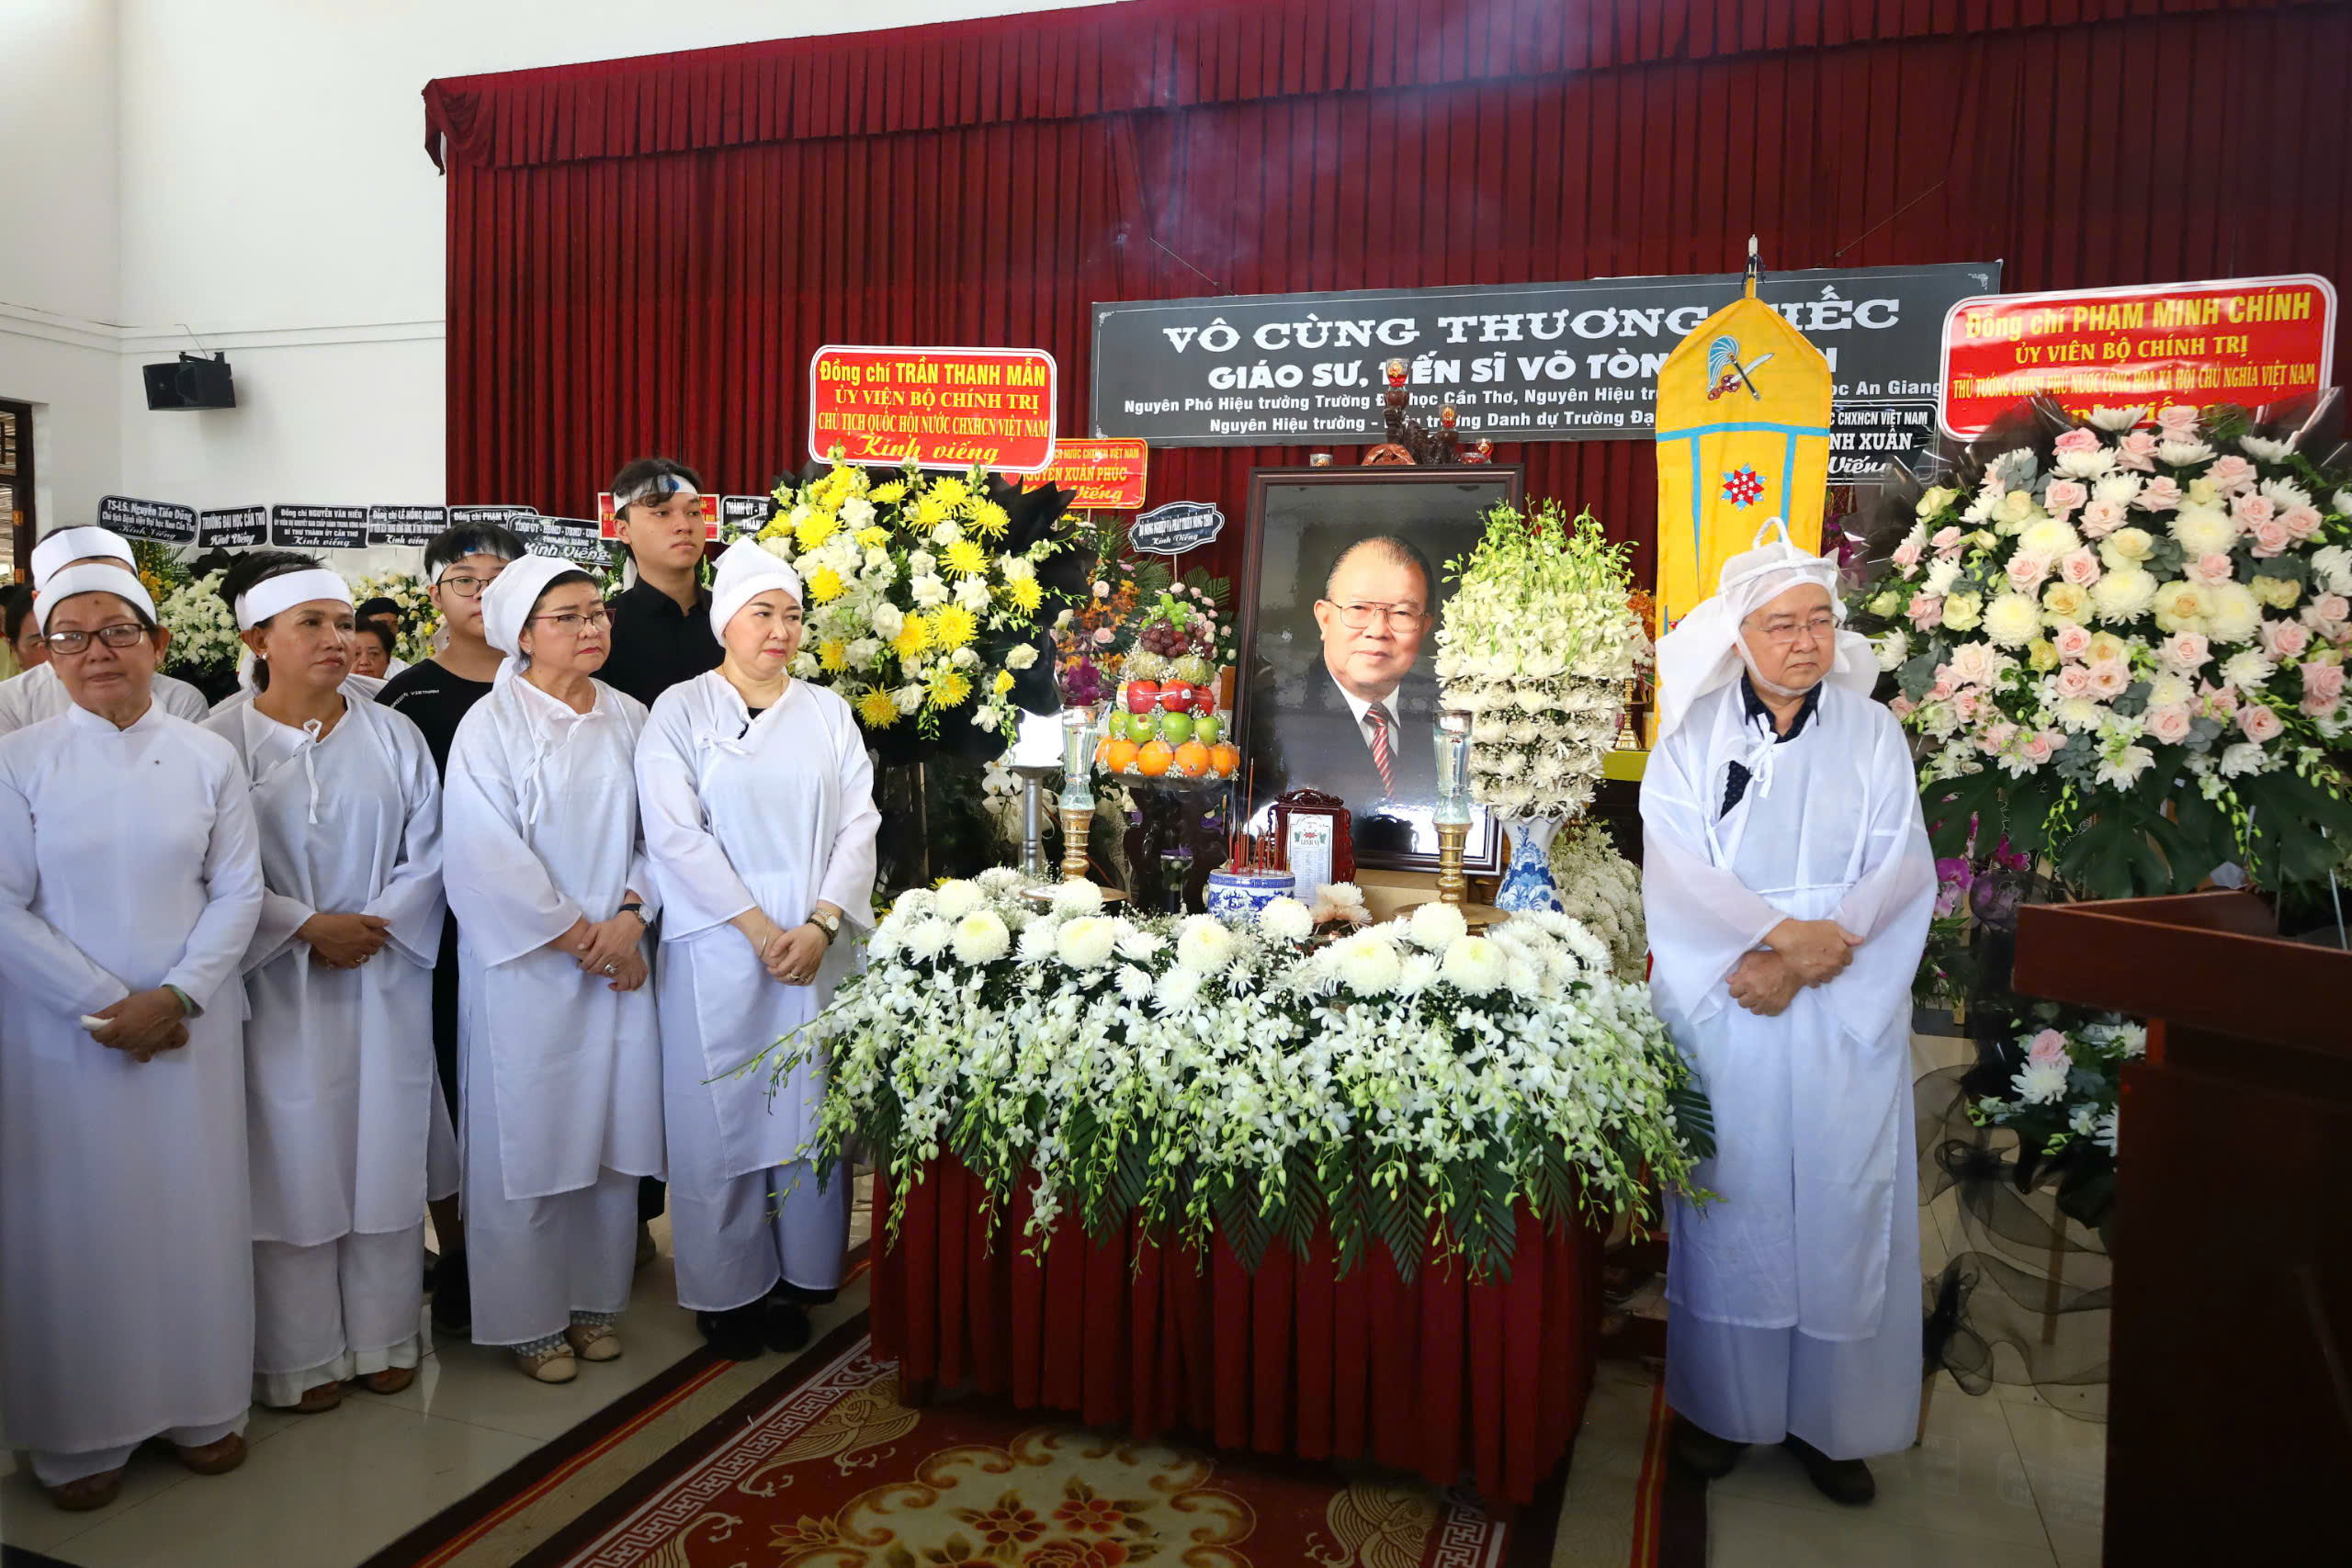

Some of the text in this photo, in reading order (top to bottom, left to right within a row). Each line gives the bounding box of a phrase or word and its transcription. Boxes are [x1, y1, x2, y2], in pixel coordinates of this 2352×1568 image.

[1162, 317, 1241, 354] VÔ
[1252, 312, 1420, 351] CÙNG
[1769, 284, 1900, 331] IẾC
[1965, 288, 2312, 342] Đồng chí PHẠM MINH CHÍNH
[2015, 333, 2249, 364] ỦY VIÊN BỘ CHÍNH TRỊ
[820, 355, 1046, 387] Đồng chí TRẦN THANH MẪN
[1207, 359, 1304, 390] GIÁO
[1311, 359, 1369, 389] SƯ,
[1470, 351, 1507, 383] SĨ
[1516, 349, 1577, 381] VÕ
[1586, 347, 1669, 379] TÒN
[1953, 373, 1973, 399] THỦ
[1975, 372, 2009, 398] TƯỚNG
[2071, 368, 2100, 394] NƯỚC
[2175, 363, 2196, 394] HỘI
[2198, 361, 2220, 389] CHỦ
[2222, 361, 2258, 388] NGHĨA
[2261, 359, 2288, 391] VIỆT
[2289, 364, 2316, 385] NAM
[835, 384, 1039, 415] ỦY VIÊN BỘ CHÍNH TRỊ
[1125, 398, 1180, 415] Nguyên
[1184, 397, 1214, 412] Phó
[1218, 396, 1253, 412] Hiệu
[1258, 395, 1309, 411] trưởng
[1315, 393, 1370, 410] Trường
[1408, 392, 1439, 408] học
[1443, 389, 1476, 405] Cần
[1482, 389, 1519, 406] Thơ,
[1524, 388, 1589, 405] Nguyên
[1594, 387, 1634, 404] Hiệu
[1855, 380, 1881, 396] An
[1887, 379, 1939, 397] Giang
[818, 407, 1049, 442] CHỦ TỊCH QUỐC HỘI NƯỚC CHXHCN VIỆT NAM
[1210, 417, 1267, 434] Nguyên
[1272, 417, 1307, 434] Hiệu
[1313, 415, 1365, 431] trưởng
[1487, 412, 1531, 426] Danh
[1536, 412, 1559, 428] dự
[1564, 411, 1624, 428] Trường
[1630, 410, 1655, 426] Đạ
[1838, 412, 1878, 425] CHXHCN
[1880, 410, 1902, 428] VIỆT
[1904, 412, 1928, 425] NAM
[854, 434, 1000, 465] Kính viếng
[1109, 446, 1124, 460] VIỆT
[1124, 447, 1140, 459] NAM
[1829, 427, 1913, 450] NH XUÂN
[1064, 463, 1096, 481] XUÂN
[1096, 462, 1128, 481] PHÚC
[423, 510, 443, 521] QUANG
[482, 512, 502, 523] PHẠM
